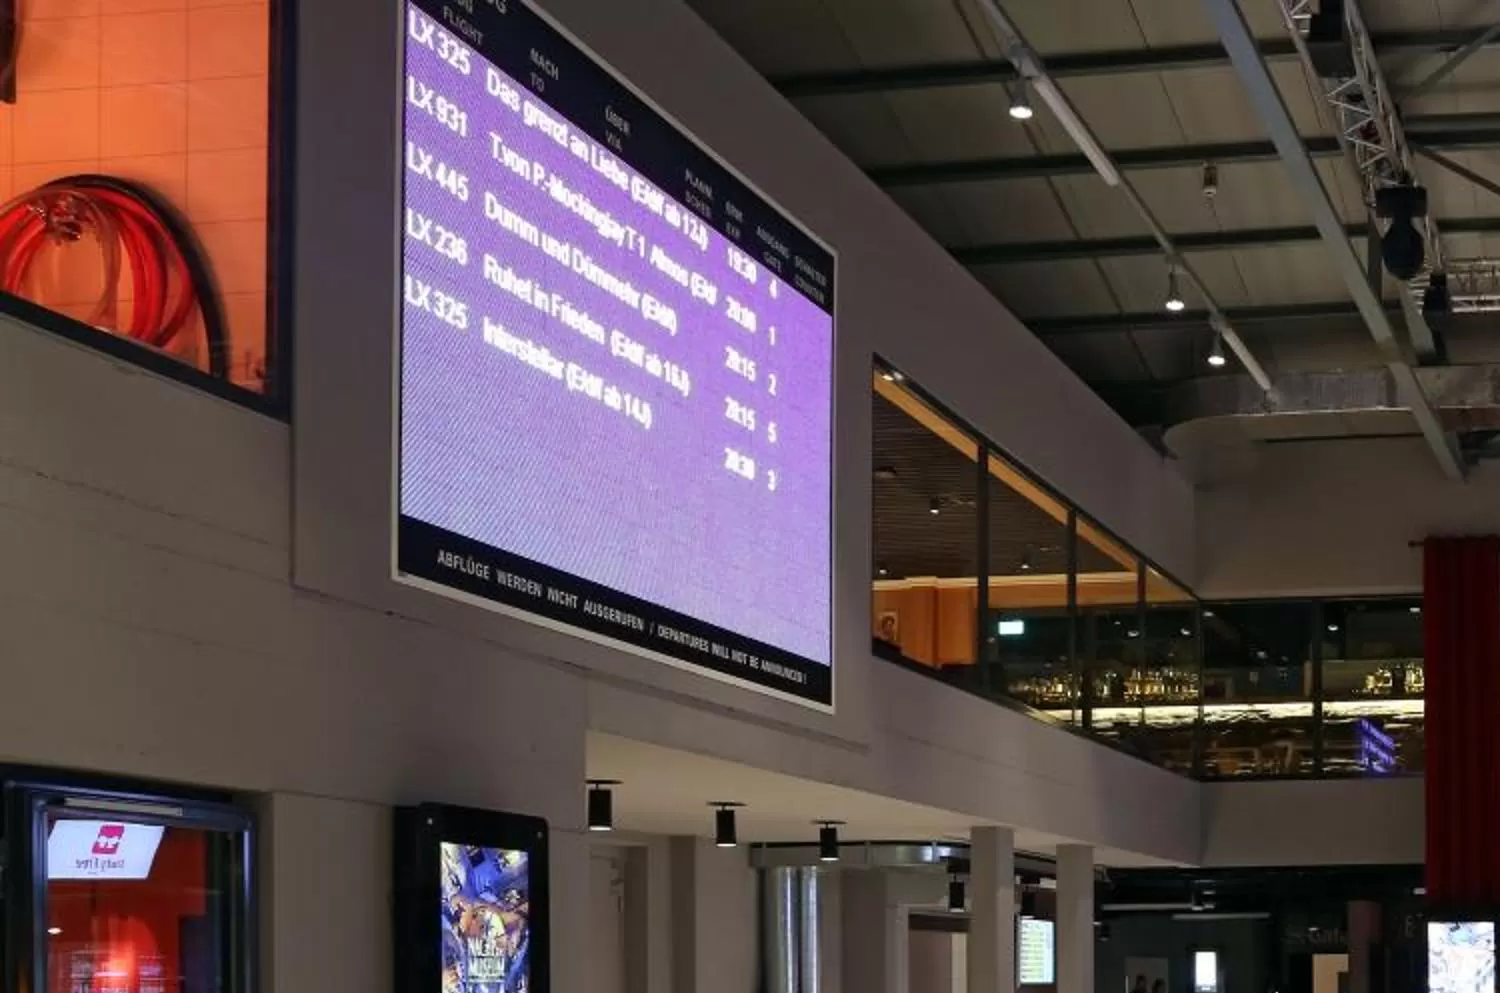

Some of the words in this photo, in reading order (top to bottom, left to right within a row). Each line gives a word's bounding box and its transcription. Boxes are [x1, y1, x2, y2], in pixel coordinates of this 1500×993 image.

[408, 75, 434, 115] LX
[435, 95, 466, 136] 931
[409, 9, 434, 50] LX
[437, 31, 470, 74] 325
[486, 67, 520, 111] Das
[569, 134, 589, 162] an
[590, 144, 629, 190] Liebe
[407, 141, 432, 180] LX
[434, 162, 468, 201] 445
[484, 191, 539, 247] Dumm
[540, 232, 570, 266] und
[404, 274, 431, 311] LX
[432, 289, 468, 329] 325
[482, 315, 565, 380] Interstellar
[406, 207, 432, 245] LX
[433, 225, 467, 265] 236
[483, 253, 533, 304] Ruhet
[533, 283, 550, 313] in
[550, 292, 605, 345] Frieden
[437, 549, 490, 580] ABFLÜGE
[496, 569, 543, 597] WERDEN
[547, 587, 578, 609] NICHT
